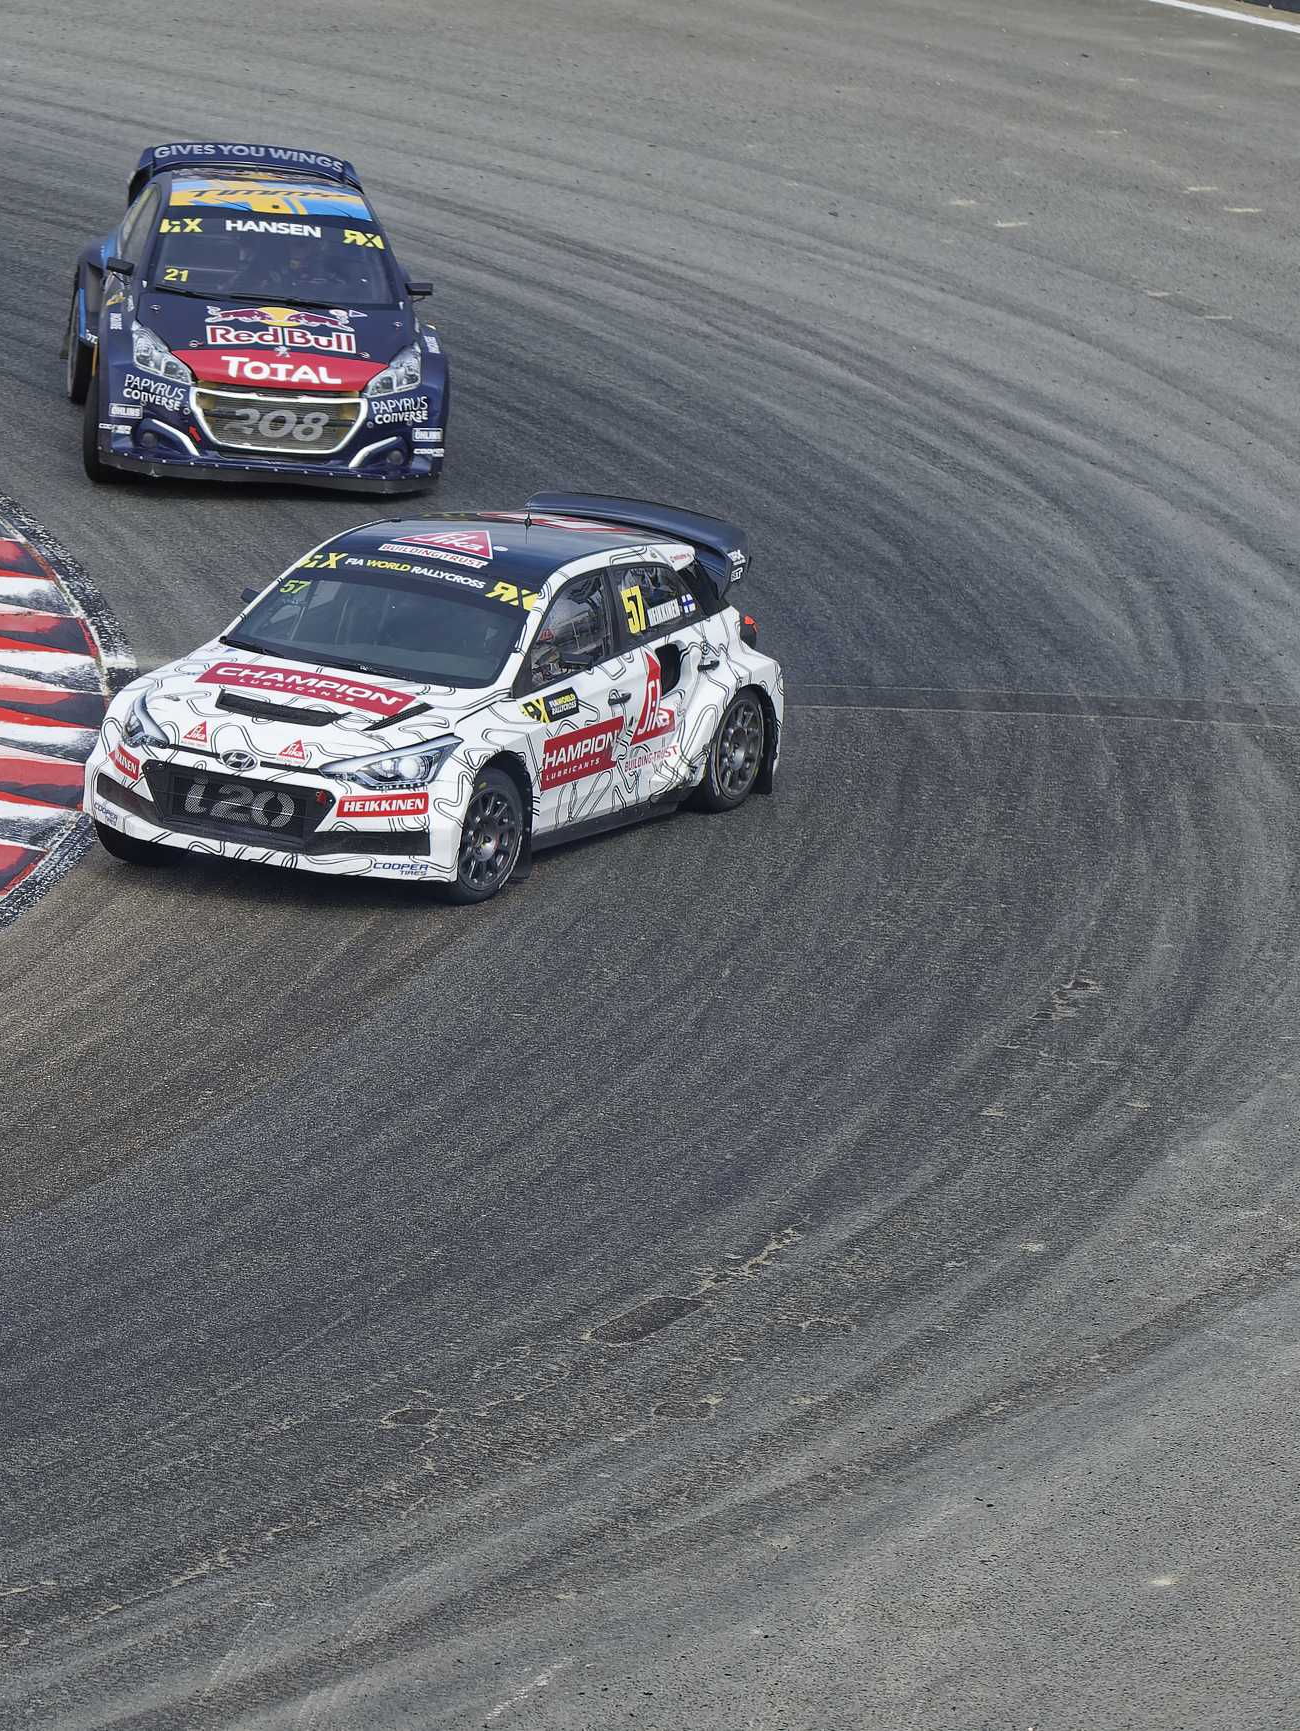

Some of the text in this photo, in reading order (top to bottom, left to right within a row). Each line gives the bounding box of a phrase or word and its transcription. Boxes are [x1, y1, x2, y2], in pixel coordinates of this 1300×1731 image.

[154, 144, 344, 173] GIVES YOU WINGS
[225, 219, 322, 238] HANSEN
[163, 268, 189, 282] 21
[207, 326, 356, 353] Red Bull
[221, 356, 342, 384] TOTAL
[124, 374, 187, 400] PAPYRUS
[371, 396, 428, 414] PAPYRUS
[223, 408, 330, 441] 208
[345, 557, 364, 567] FIA
[367, 559, 411, 572] WORLD
[410, 565, 487, 589] RALLYCROSS
[279, 580, 312, 594] 57
[621, 585, 646, 634] 57
[216, 666, 398, 705] CHAMPION
[239, 678, 354, 702] LUBRICANTS
[546, 758, 600, 780] LUBRICANTS
[343, 798, 425, 812] HEIKKINEN
[373, 862, 429, 870] COOPER
